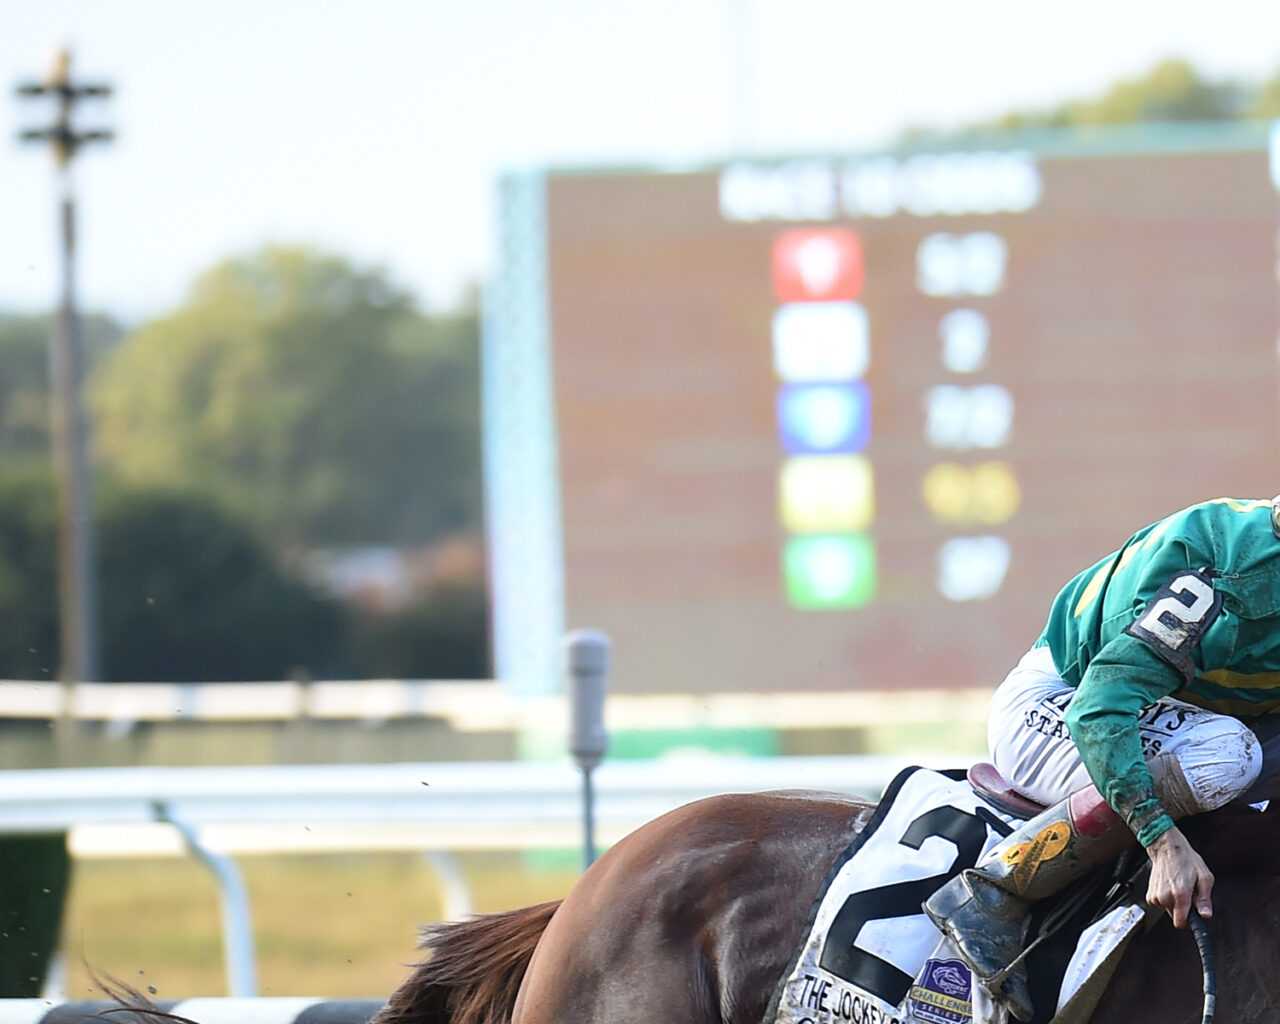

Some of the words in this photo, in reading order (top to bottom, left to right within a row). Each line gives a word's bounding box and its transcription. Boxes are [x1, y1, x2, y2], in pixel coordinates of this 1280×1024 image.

[1139, 574, 1215, 652] 2
[819, 805, 990, 1008] 2
[799, 974, 833, 1013] THE
[911, 988, 973, 1014] CHALLENGE
[920, 1004, 959, 1020] SERIES
